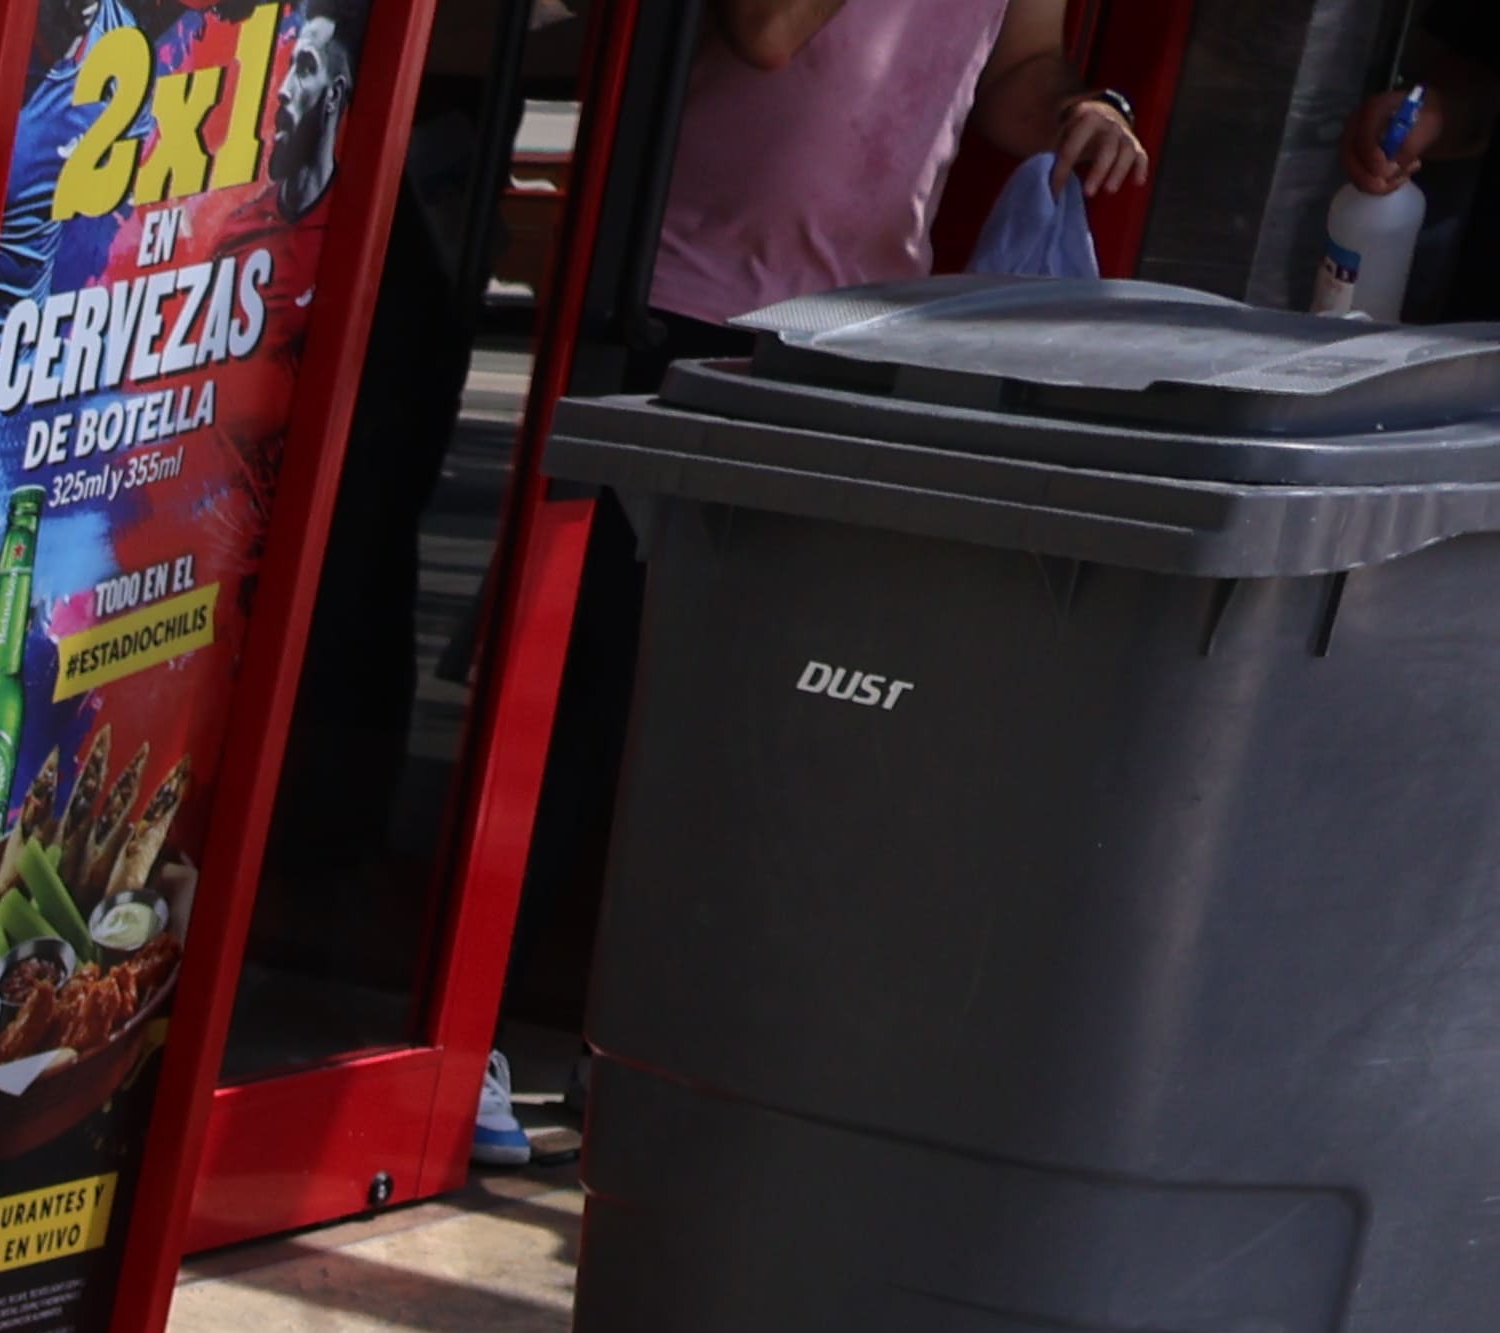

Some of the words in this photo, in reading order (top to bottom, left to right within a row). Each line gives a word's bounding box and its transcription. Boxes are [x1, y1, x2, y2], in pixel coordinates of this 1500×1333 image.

[52, 3, 280, 221] 2x1
[137, 207, 181, 267] EN
[23, 413, 72, 469] DE
[74, 380, 215, 458] BOTELLA
[48, 464, 109, 507] 325ml
[107, 468, 124, 501] y
[124, 446, 184, 489] 355ml
[95, 571, 141, 617] TODO
[143, 562, 169, 602] EN
[172, 555, 194, 592] EL
[66, 605, 208, 680] #ESTADIOCHILIS
[796, 660, 915, 710] DUST
[93, 1183, 105, 1208] Y
[4, 1235, 30, 1262] EN
[36, 1223, 81, 1254] VIVO
